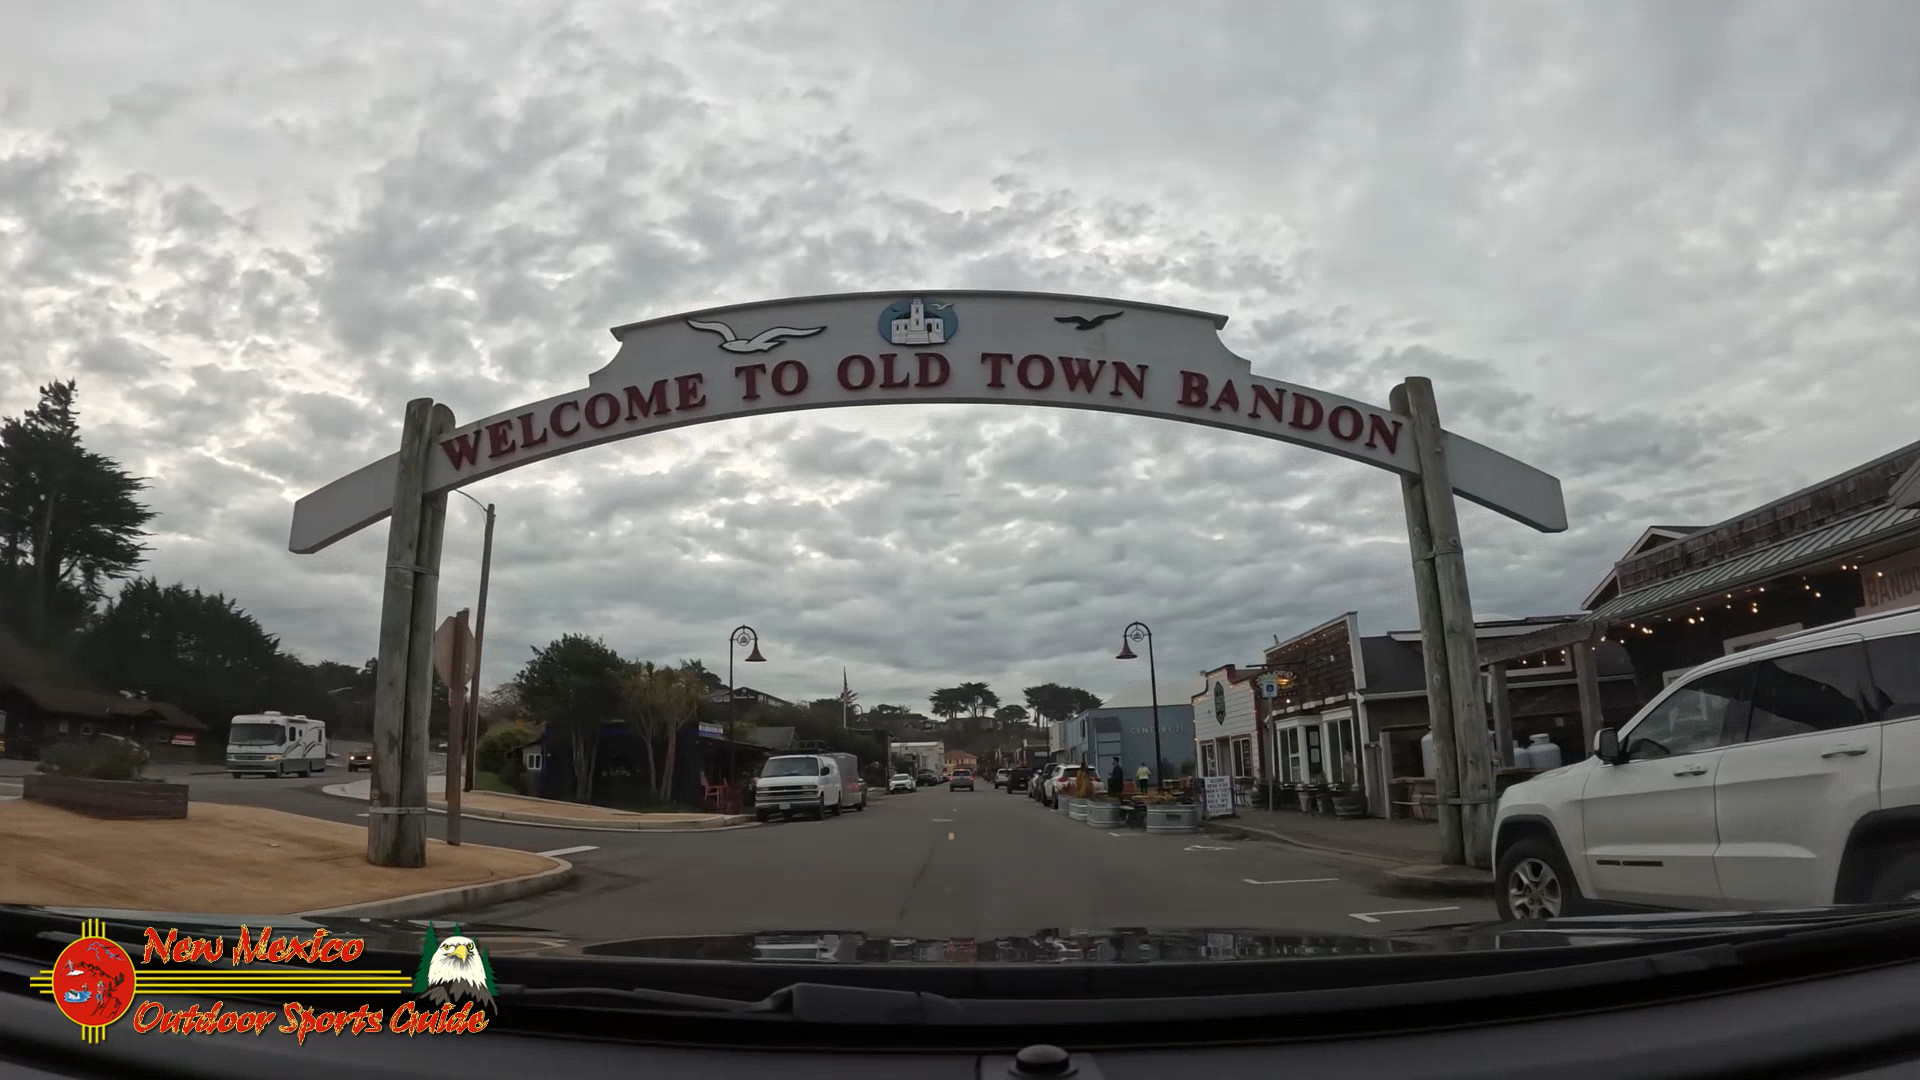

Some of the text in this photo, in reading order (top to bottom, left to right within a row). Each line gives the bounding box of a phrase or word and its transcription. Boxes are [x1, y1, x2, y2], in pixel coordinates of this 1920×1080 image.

[440, 352, 1403, 470] WELCOME TO OLD TOWN BANDON
